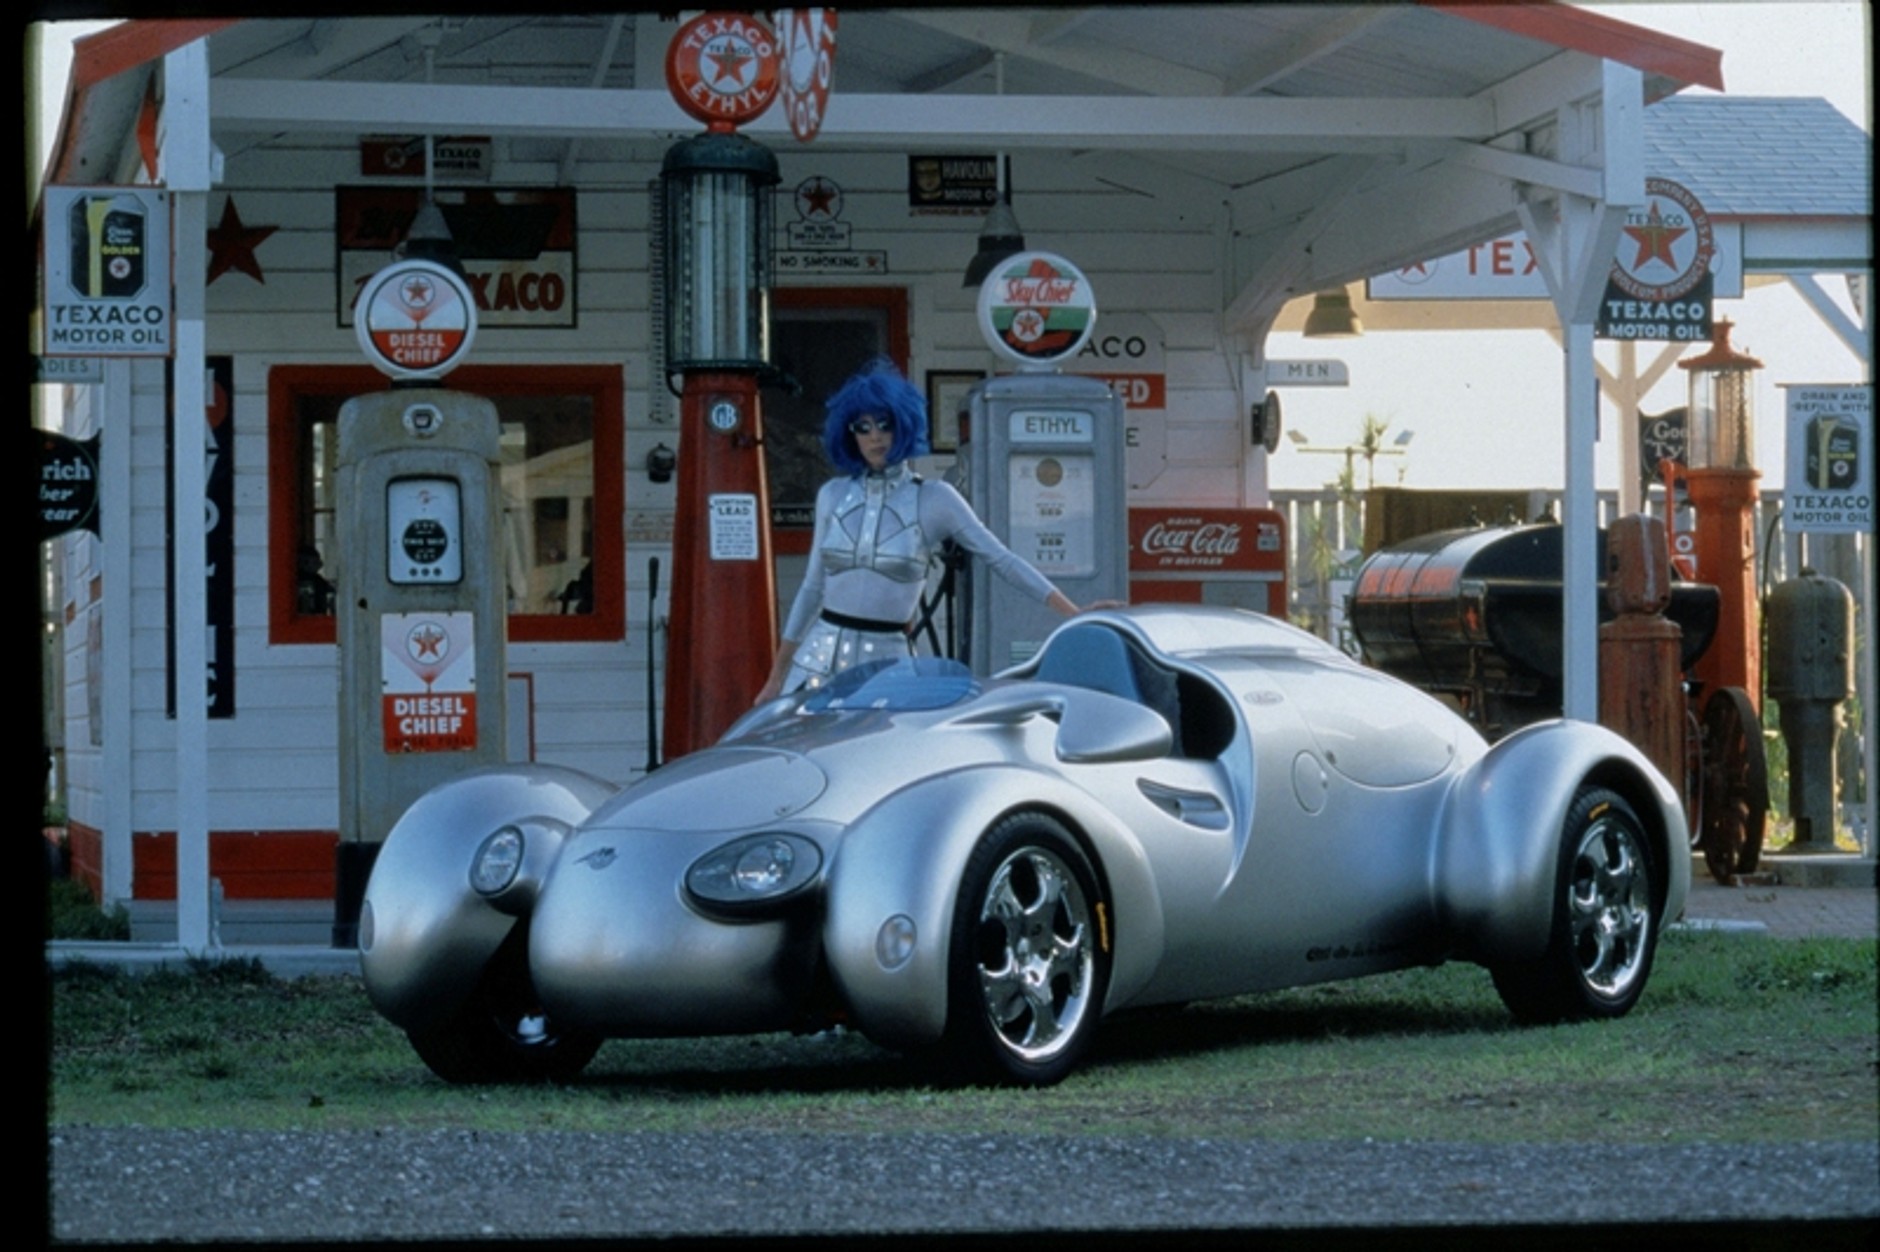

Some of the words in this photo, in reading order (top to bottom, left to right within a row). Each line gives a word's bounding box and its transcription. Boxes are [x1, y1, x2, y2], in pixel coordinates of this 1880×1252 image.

[685, 18, 772, 57] TEXACO
[690, 82, 768, 114] ETHYL
[1626, 212, 1684, 225] TEXACO
[780, 256, 798, 268] NO
[803, 256, 859, 268] SMOKING
[1005, 278, 1035, 305] Sky
[1036, 276, 1077, 303] Chief
[52, 305, 164, 324] TEXACO
[1607, 301, 1705, 319] TEXACO
[51, 328, 125, 343] MOTOR
[131, 328, 165, 343] OIL
[1607, 324, 1669, 338] MOTOR
[1675, 324, 1705, 339] OIL
[388, 332, 446, 347] DIESEL
[392, 348, 442, 363] CHIEF
[1287, 363, 1329, 377] MEN
[1800, 391, 1839, 401] DRAIN
[1842, 391, 1867, 401] AND
[1024, 415, 1083, 433] ETHYL
[42, 457, 91, 480] rich
[1793, 496, 1870, 511] TEXACO
[718, 508, 751, 516] LEAD
[1793, 512, 1842, 523] MOTOR
[1846, 512, 1871, 523] OIL
[393, 697, 468, 716] DIESEL
[399, 716, 463, 735] CHIEF
